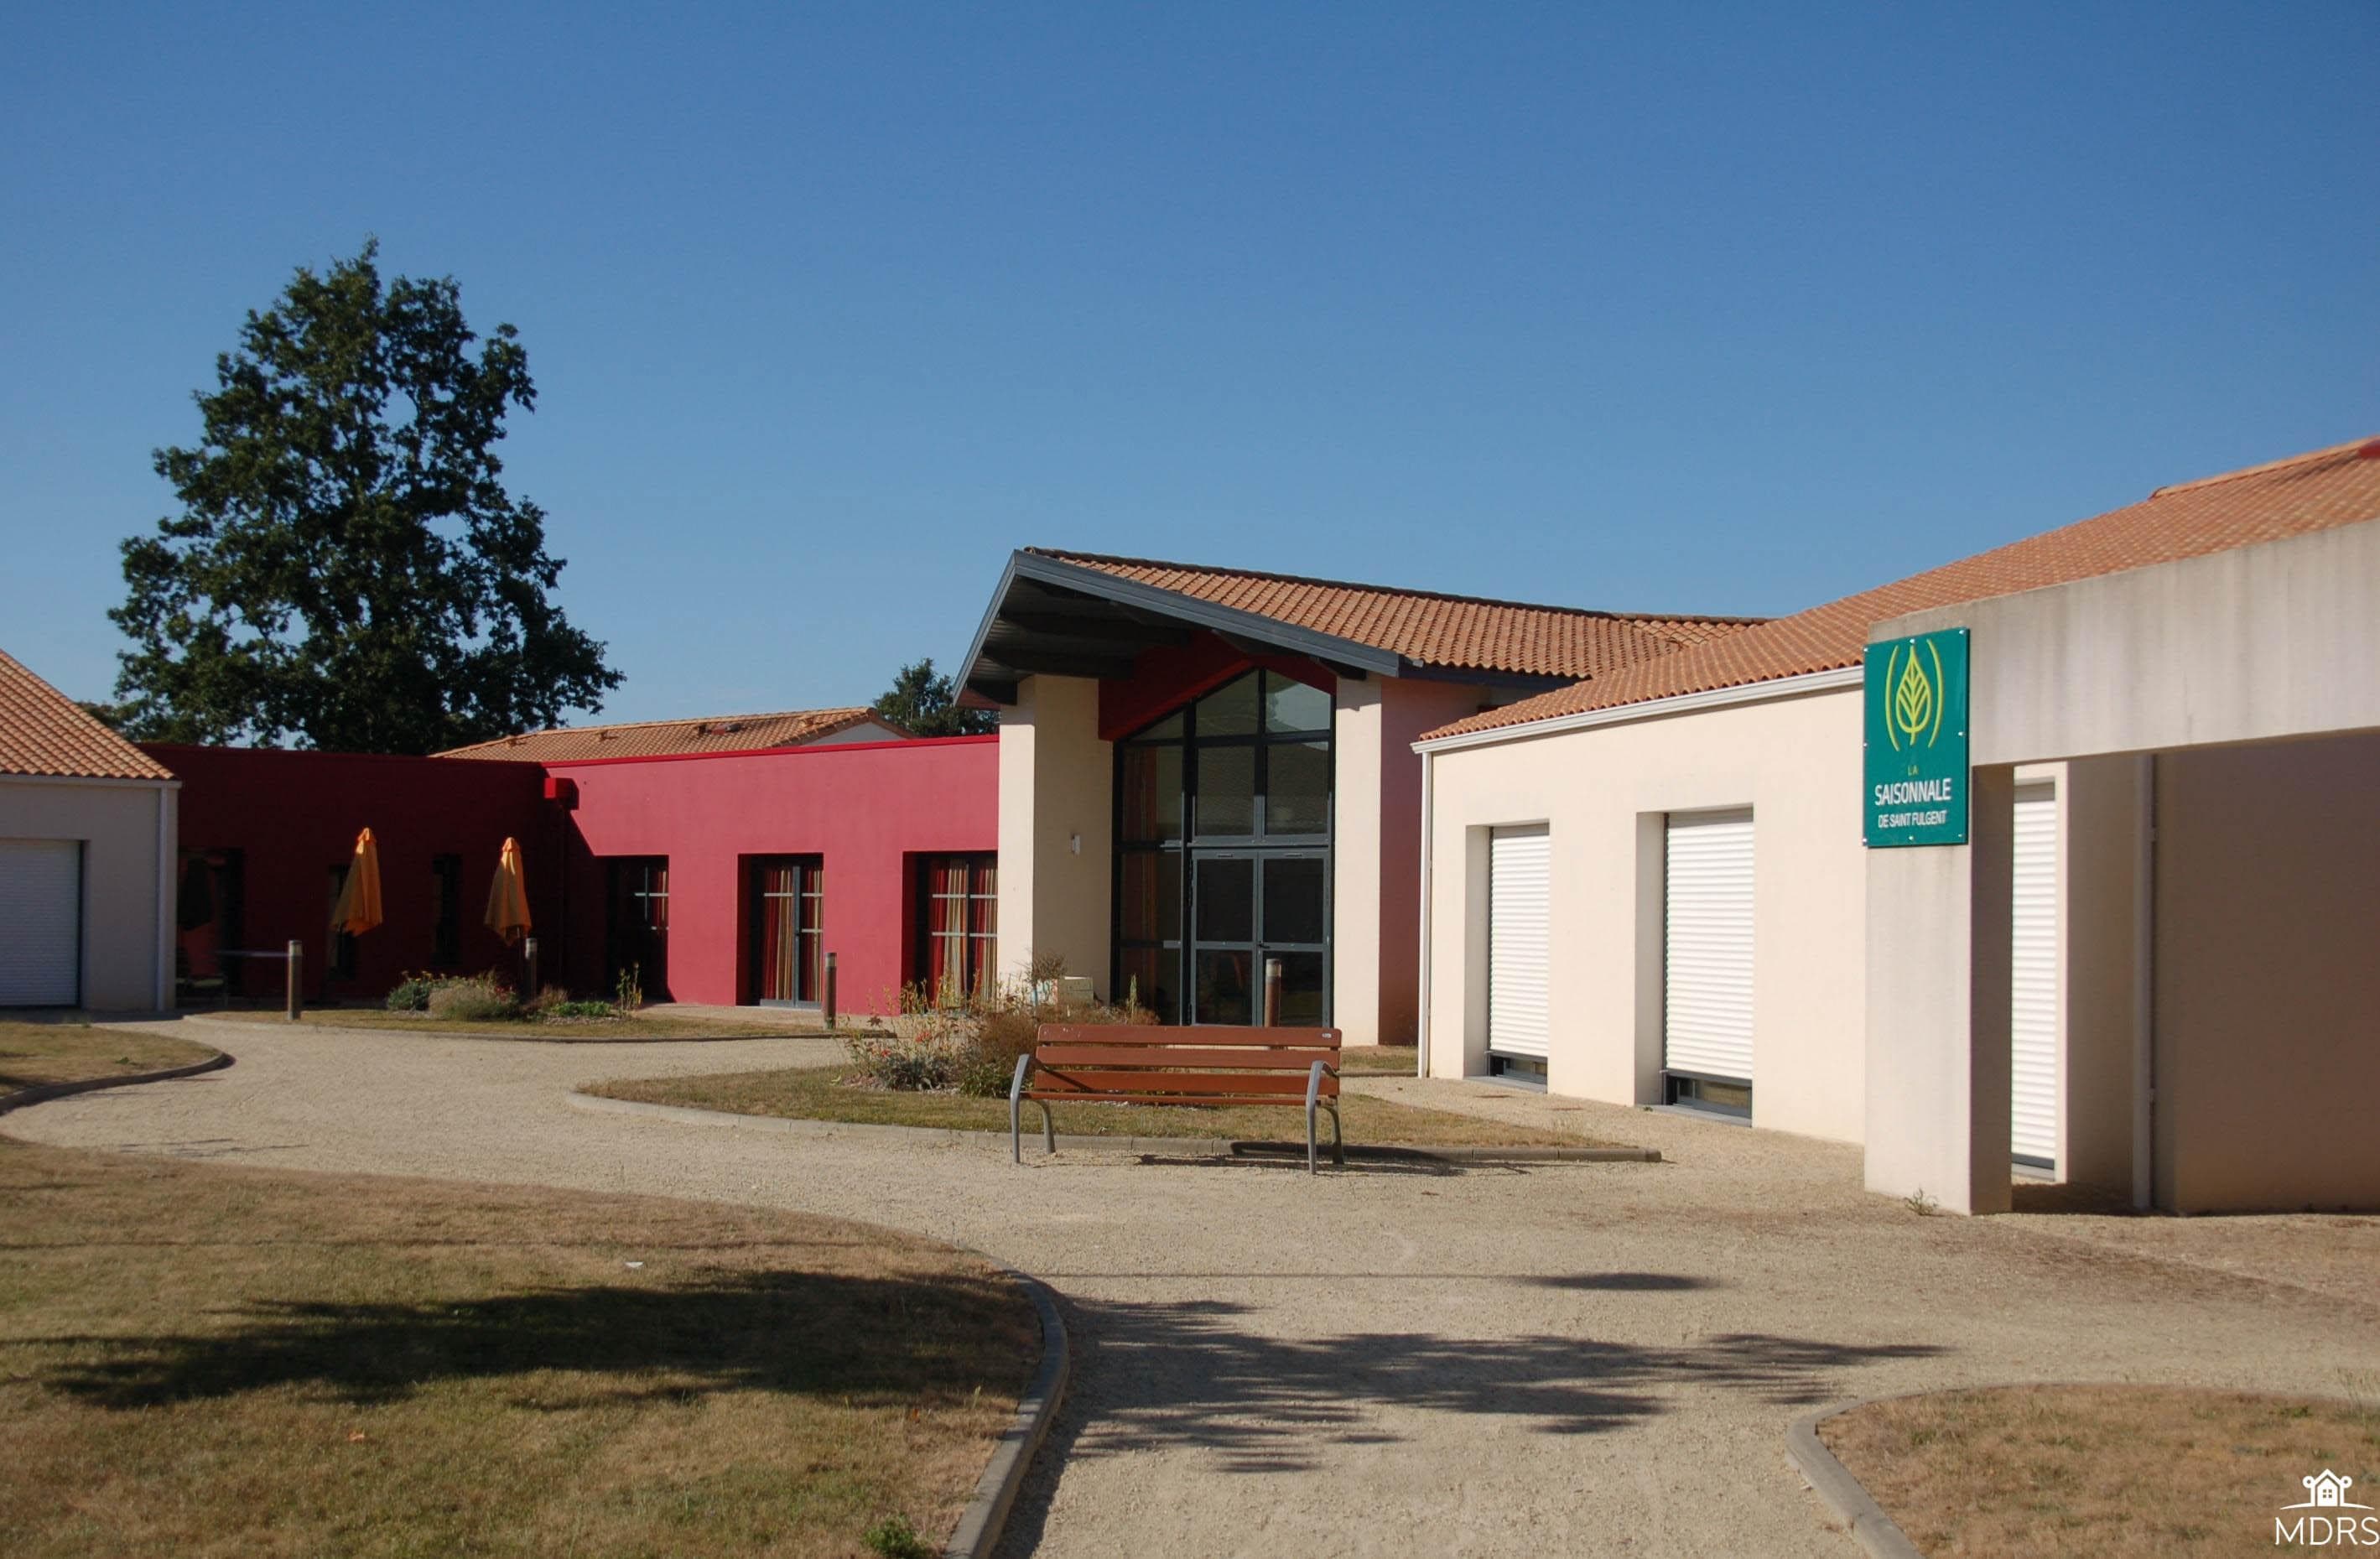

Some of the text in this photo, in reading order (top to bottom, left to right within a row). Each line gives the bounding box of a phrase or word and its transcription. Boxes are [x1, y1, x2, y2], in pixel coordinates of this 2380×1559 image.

[1908, 765, 1919, 776] LA
[1874, 778, 1951, 805] SAISONNALE
[1879, 810, 1946, 828] DE SAINT FULGENT
